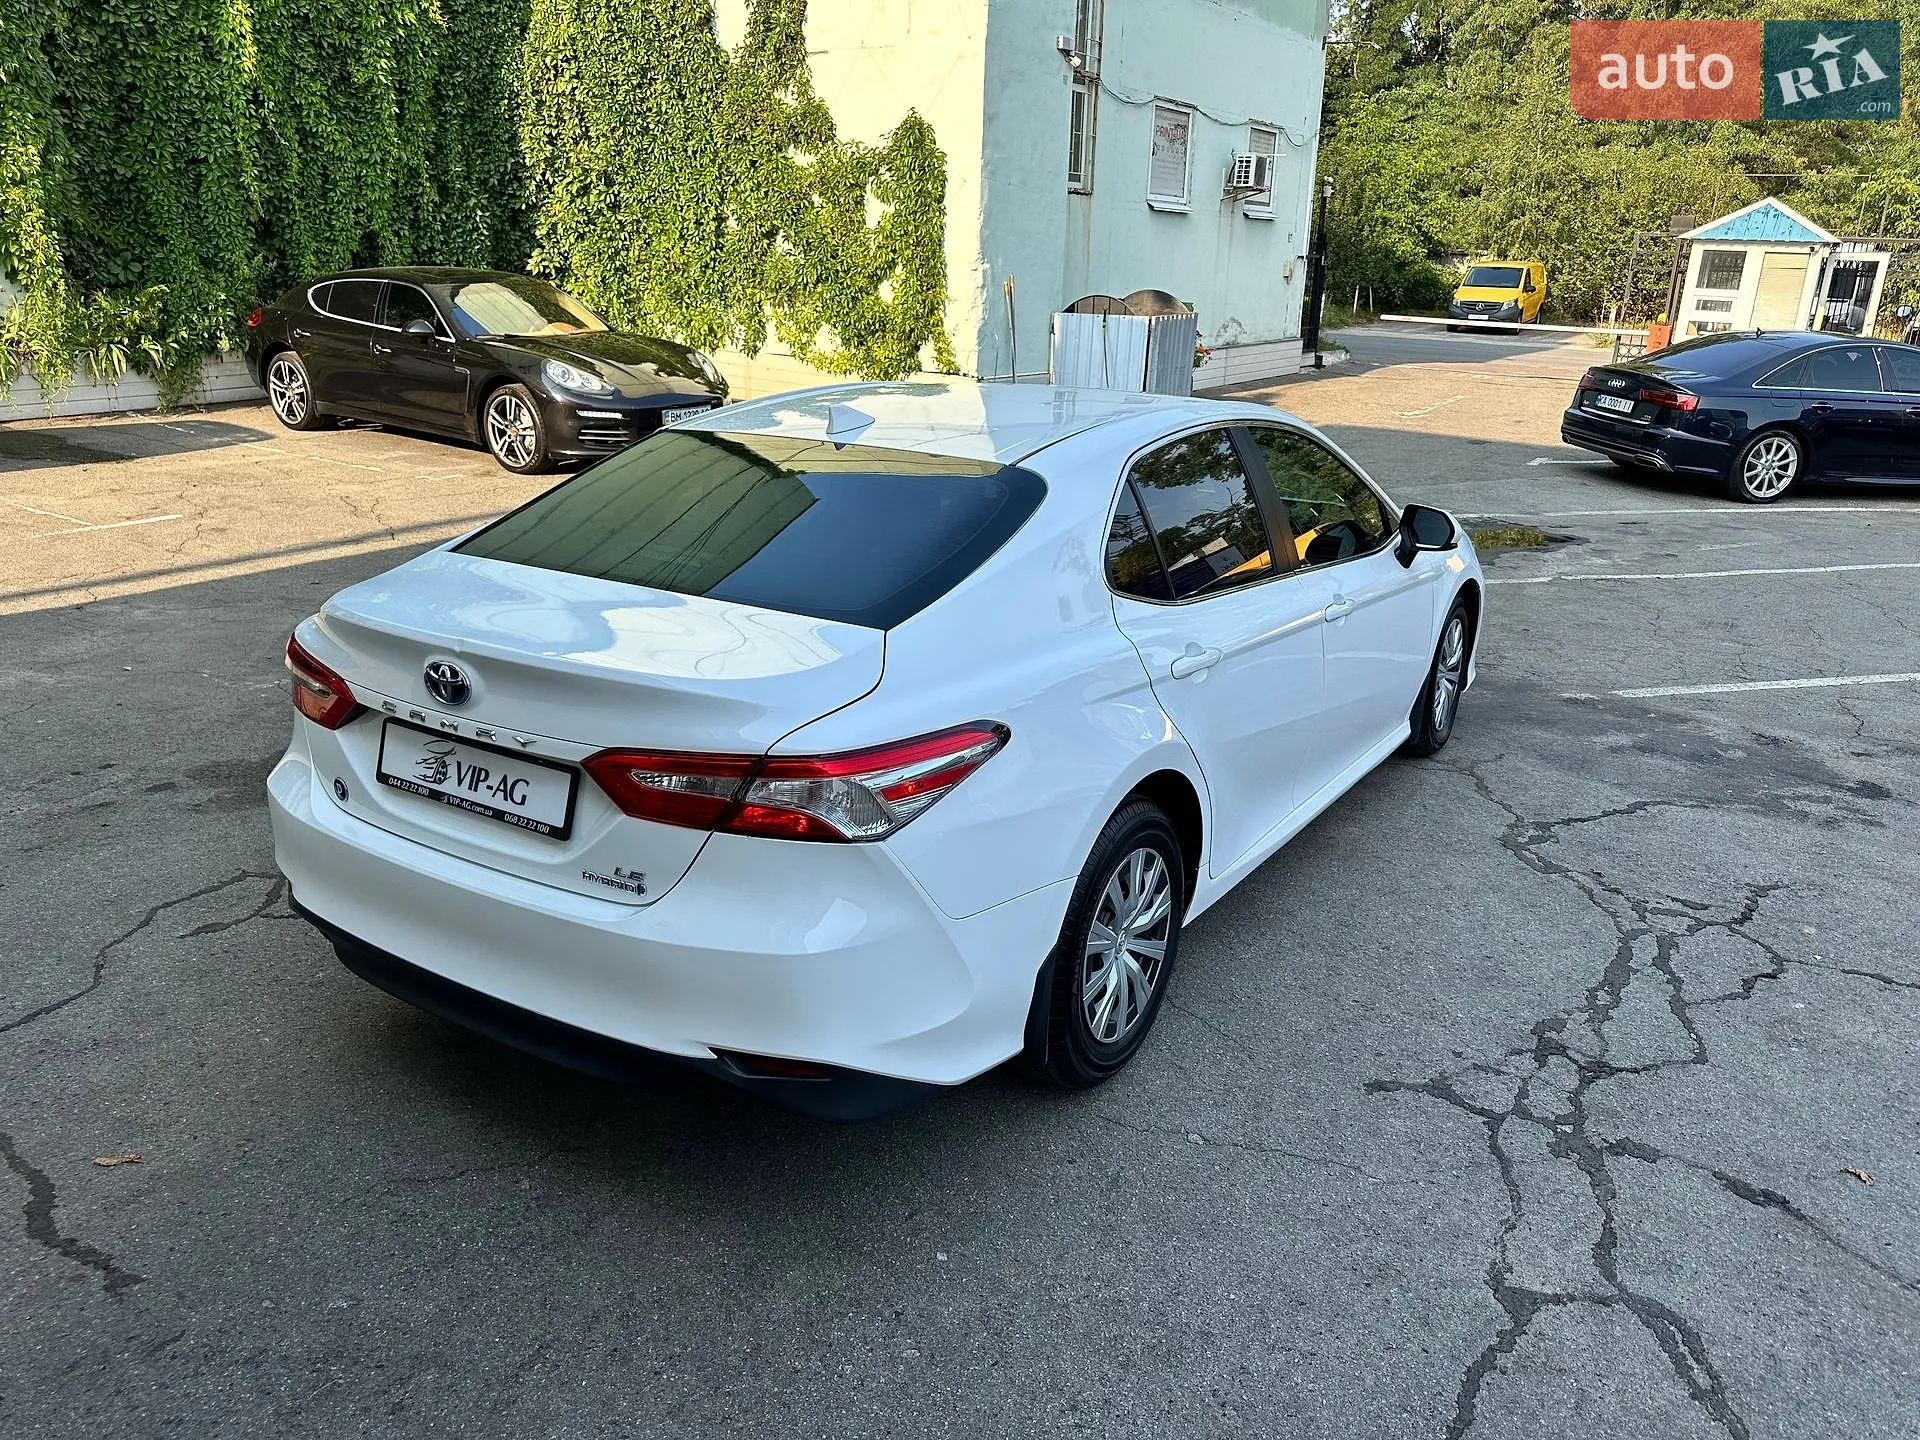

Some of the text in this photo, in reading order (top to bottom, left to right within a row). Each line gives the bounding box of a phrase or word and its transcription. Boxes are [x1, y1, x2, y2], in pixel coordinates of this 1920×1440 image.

[1608, 397, 1622, 408] 0001
[381, 700, 538, 748] CAMRY
[388, 777, 430, 796] 044 22 22 100
[456, 760, 530, 806] VIP-AG
[449, 796, 493, 816] VIP-AG.com.ua
[504, 813, 550, 834] 068 22 22 100
[581, 869, 637, 893] HYBRID
[614, 866, 646, 883] LE
